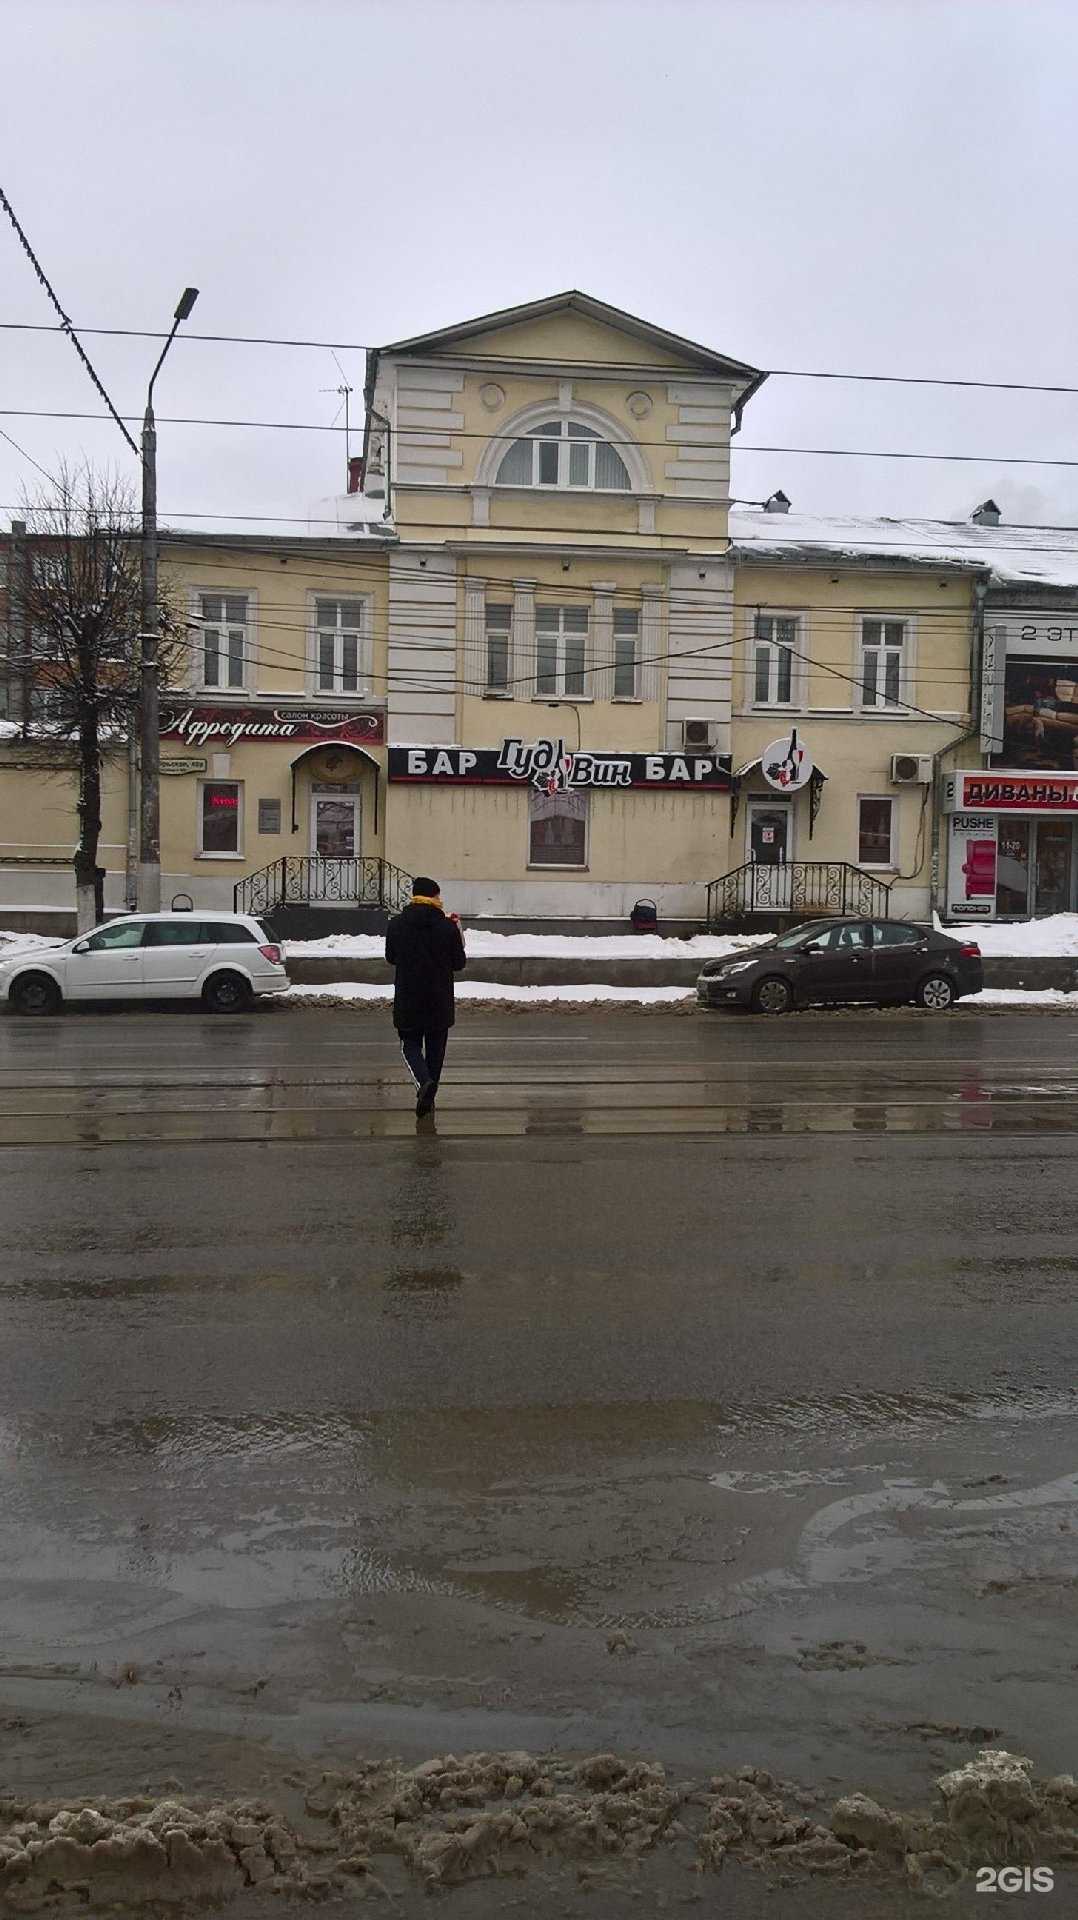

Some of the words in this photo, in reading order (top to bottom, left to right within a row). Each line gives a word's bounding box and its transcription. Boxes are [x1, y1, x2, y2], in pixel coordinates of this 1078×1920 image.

[1021, 626, 1037, 641] 2
[281, 711, 309, 720] салон
[160, 708, 298, 747] Афродита
[407, 750, 478, 775] БАР
[497, 737, 553, 779] Гуд
[569, 753, 632, 786] Вин
[645, 756, 713, 781] БАР
[968, 783, 1070, 804] ДИВАНЫ
[953, 817, 994, 829] PUSHE
